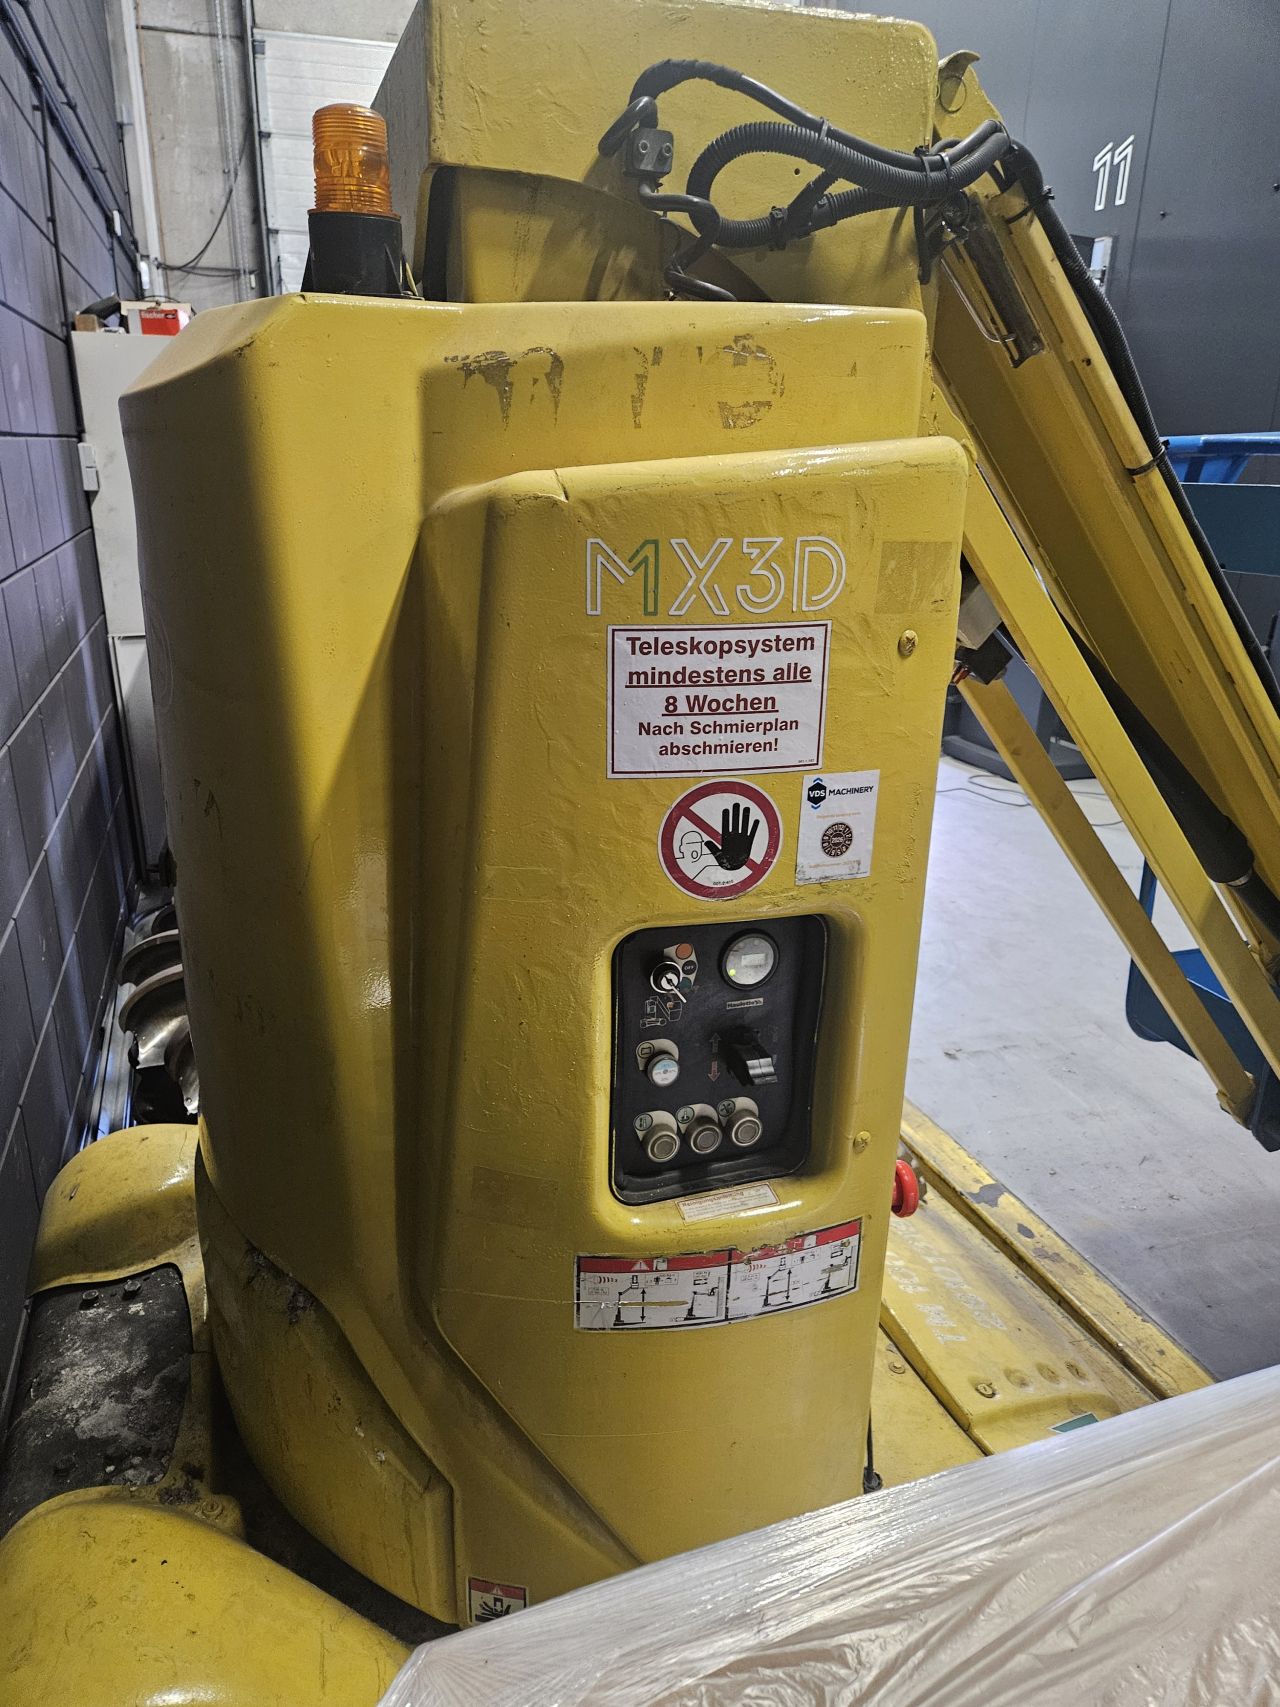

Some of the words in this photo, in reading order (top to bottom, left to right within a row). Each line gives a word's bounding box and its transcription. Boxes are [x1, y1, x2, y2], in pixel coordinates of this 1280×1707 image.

[1092, 134, 1135, 211] 11
[586, 536, 846, 616] MX3D
[626, 634, 815, 659] Teleskopsystem
[627, 666, 766, 686] mindestens
[772, 662, 812, 682] alle
[664, 695, 678, 714] 8
[685, 693, 777, 713] Wochen
[638, 721, 684, 736] Nach
[690, 717, 799, 736] Schmierplan
[658, 737, 779, 756] abschmieren!
[809, 789, 826, 797] VDS
[828, 785, 874, 796] MACHINERY
